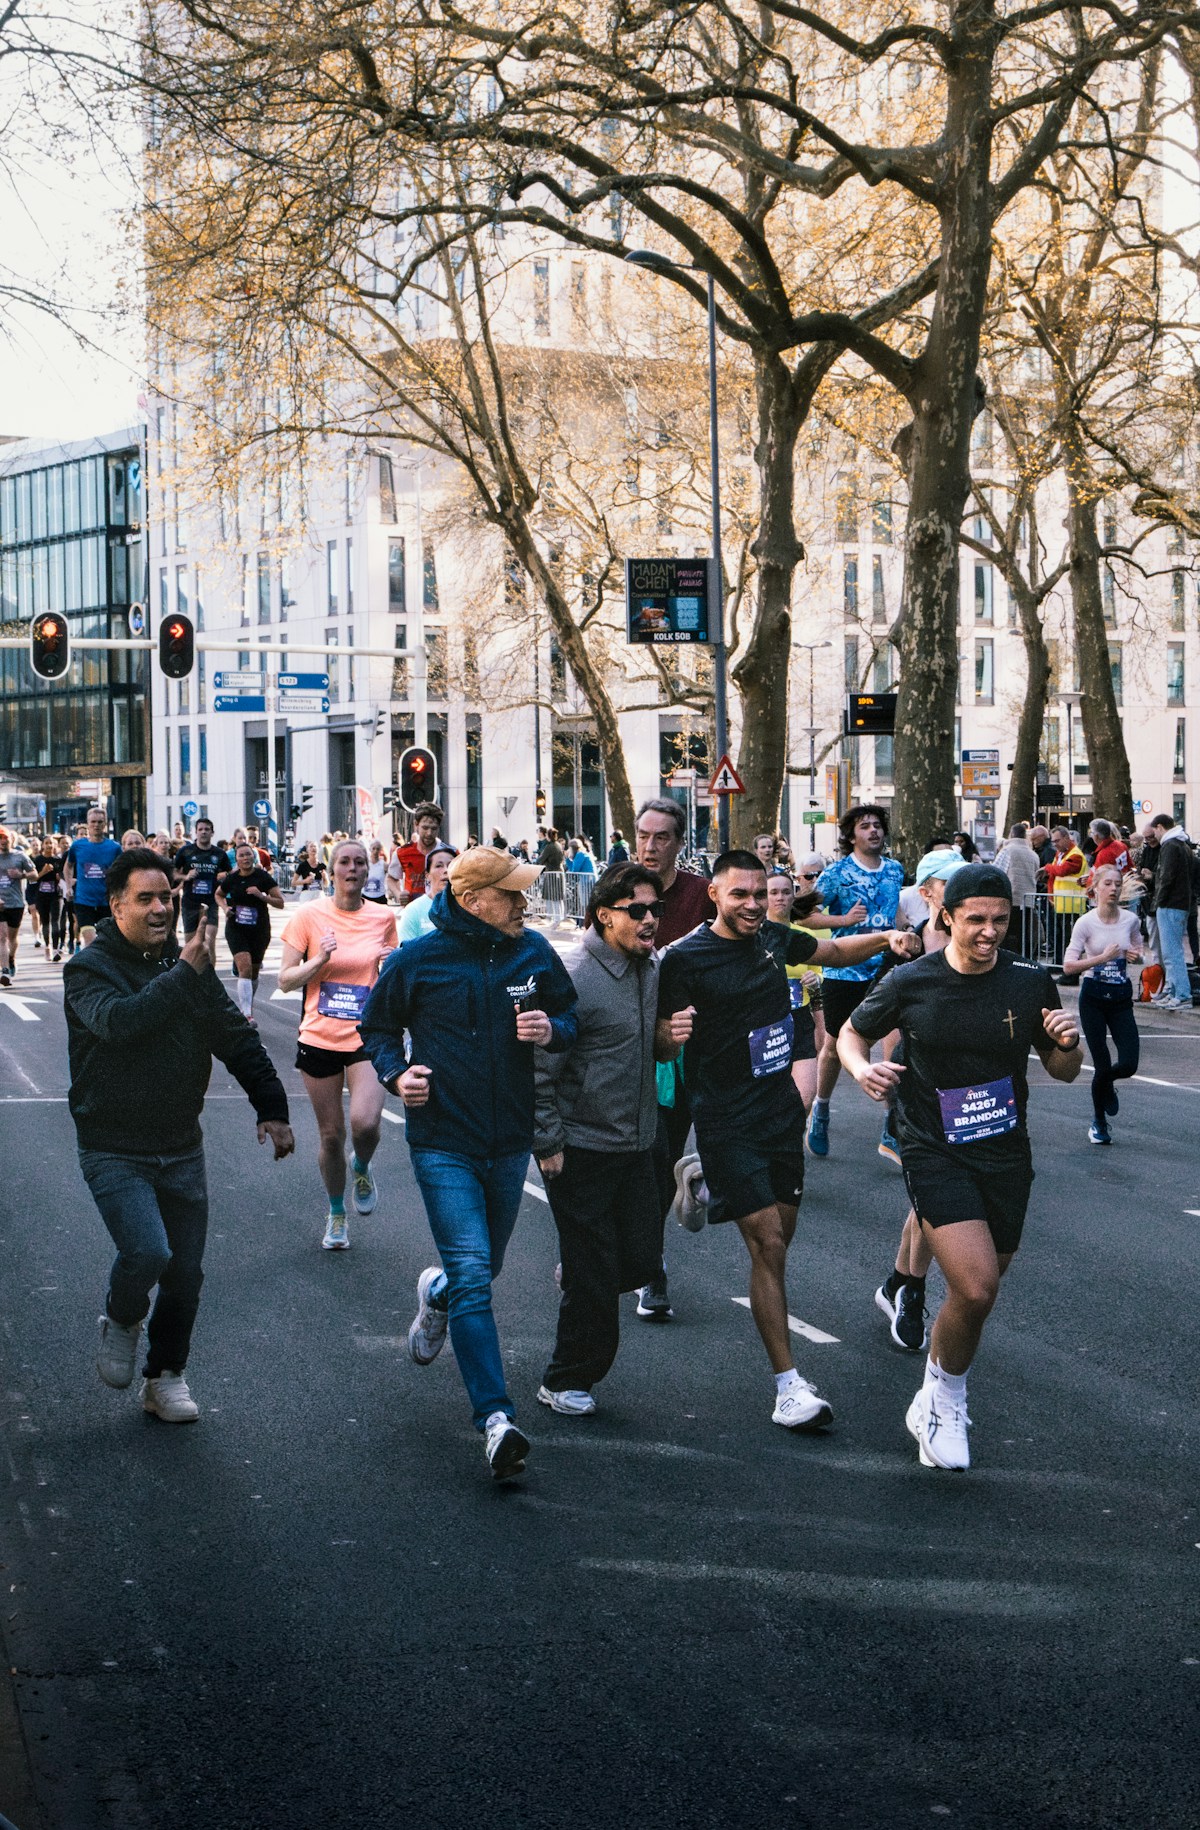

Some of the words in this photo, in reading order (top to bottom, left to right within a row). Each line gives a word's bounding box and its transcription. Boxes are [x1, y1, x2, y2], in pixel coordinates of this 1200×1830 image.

[632, 563, 676, 579] MADAM
[634, 576, 669, 589] CHEN
[654, 632, 673, 640] KOLK
[674, 632, 691, 640] 50B
[1012, 961, 1038, 969] ROGELLI
[1100, 970, 1120, 978] PUCK
[327, 1000, 359, 1010] RENEE
[967, 1089, 990, 1100] TREK
[961, 1097, 997, 1113] 34267
[953, 1107, 1008, 1127] BRANDON
